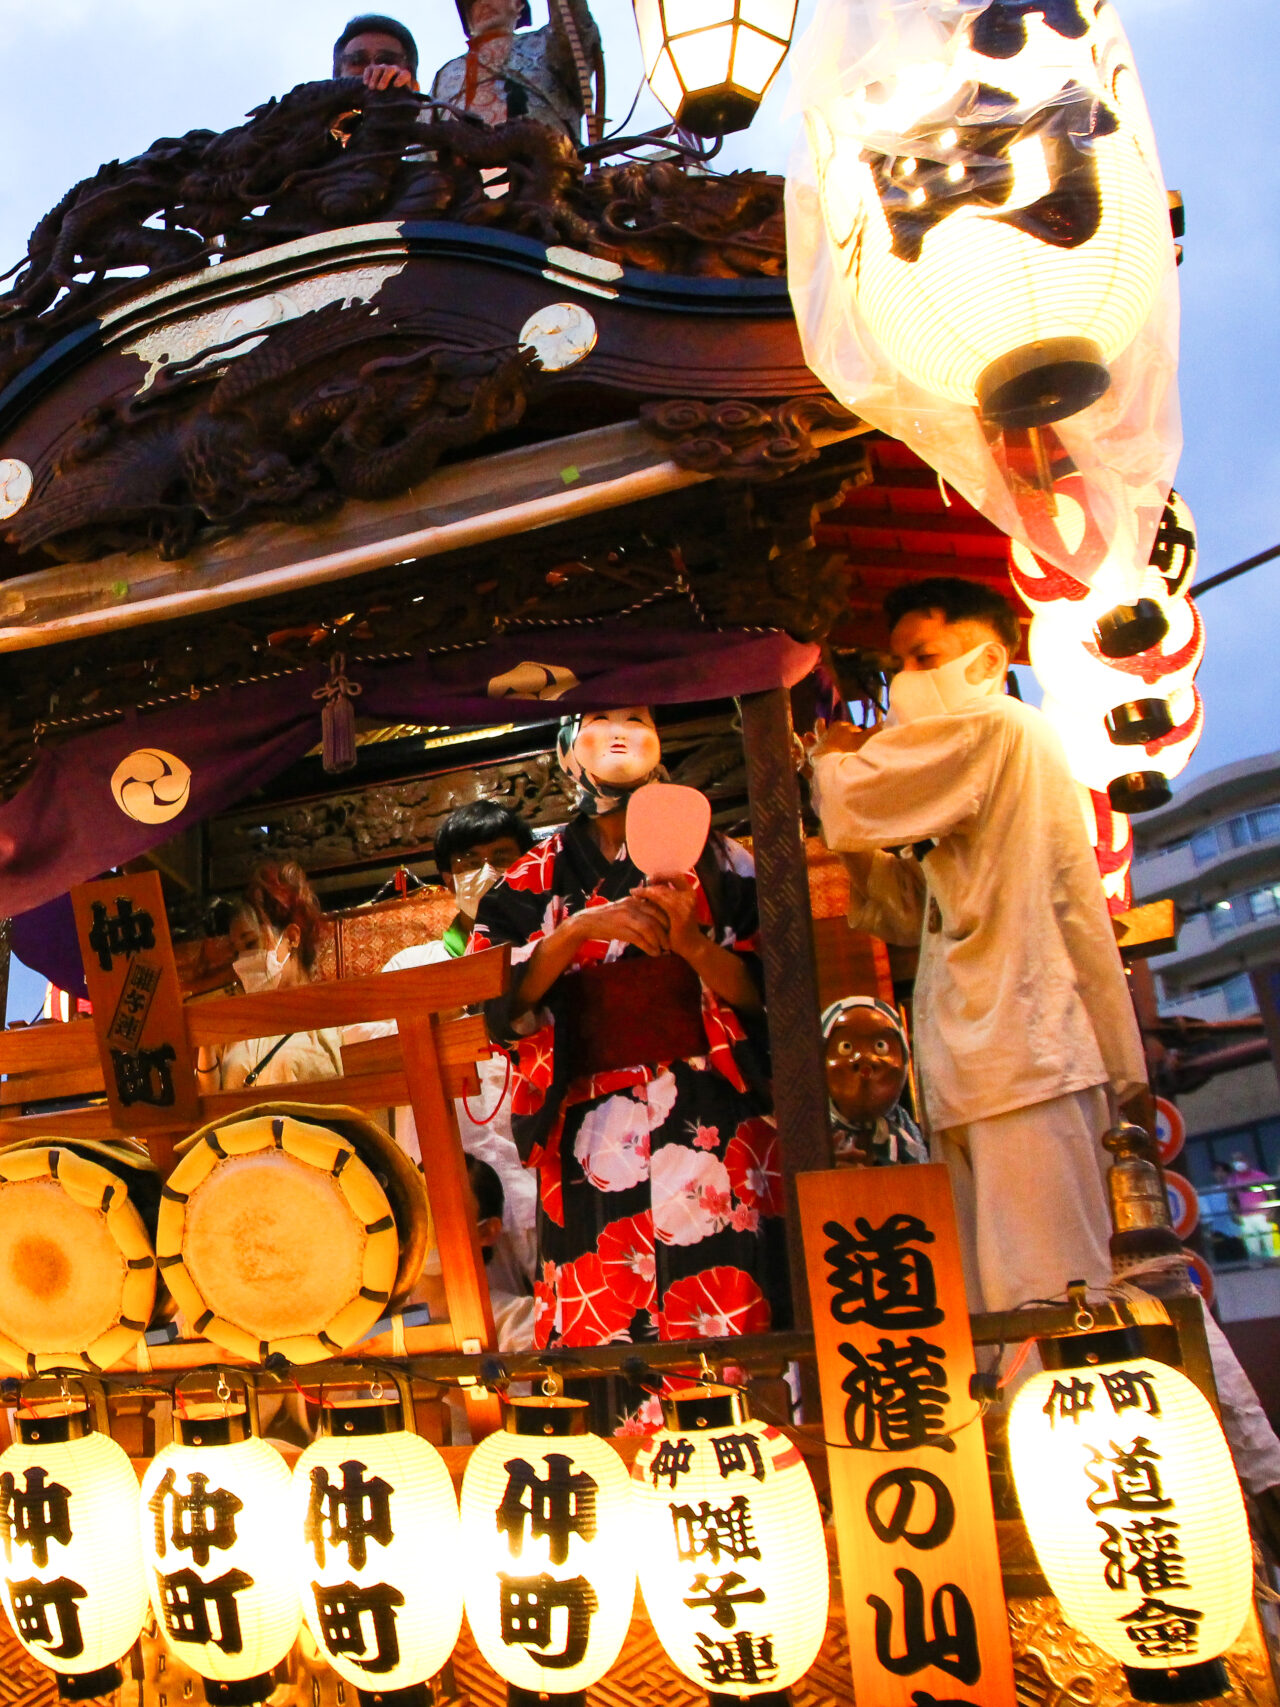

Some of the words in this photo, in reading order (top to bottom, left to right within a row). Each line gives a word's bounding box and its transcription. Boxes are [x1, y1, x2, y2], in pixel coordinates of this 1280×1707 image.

[89, 896, 176, 1107] 仲町
[650, 1432, 766, 1490] 仲町
[823, 1214, 981, 1707] 道灌の山
[1043, 1370, 1161, 1430] 仲町
[148, 1467, 254, 1654] 仲町
[304, 1460, 405, 1673] 仲町
[496, 1453, 599, 1670] 仲町
